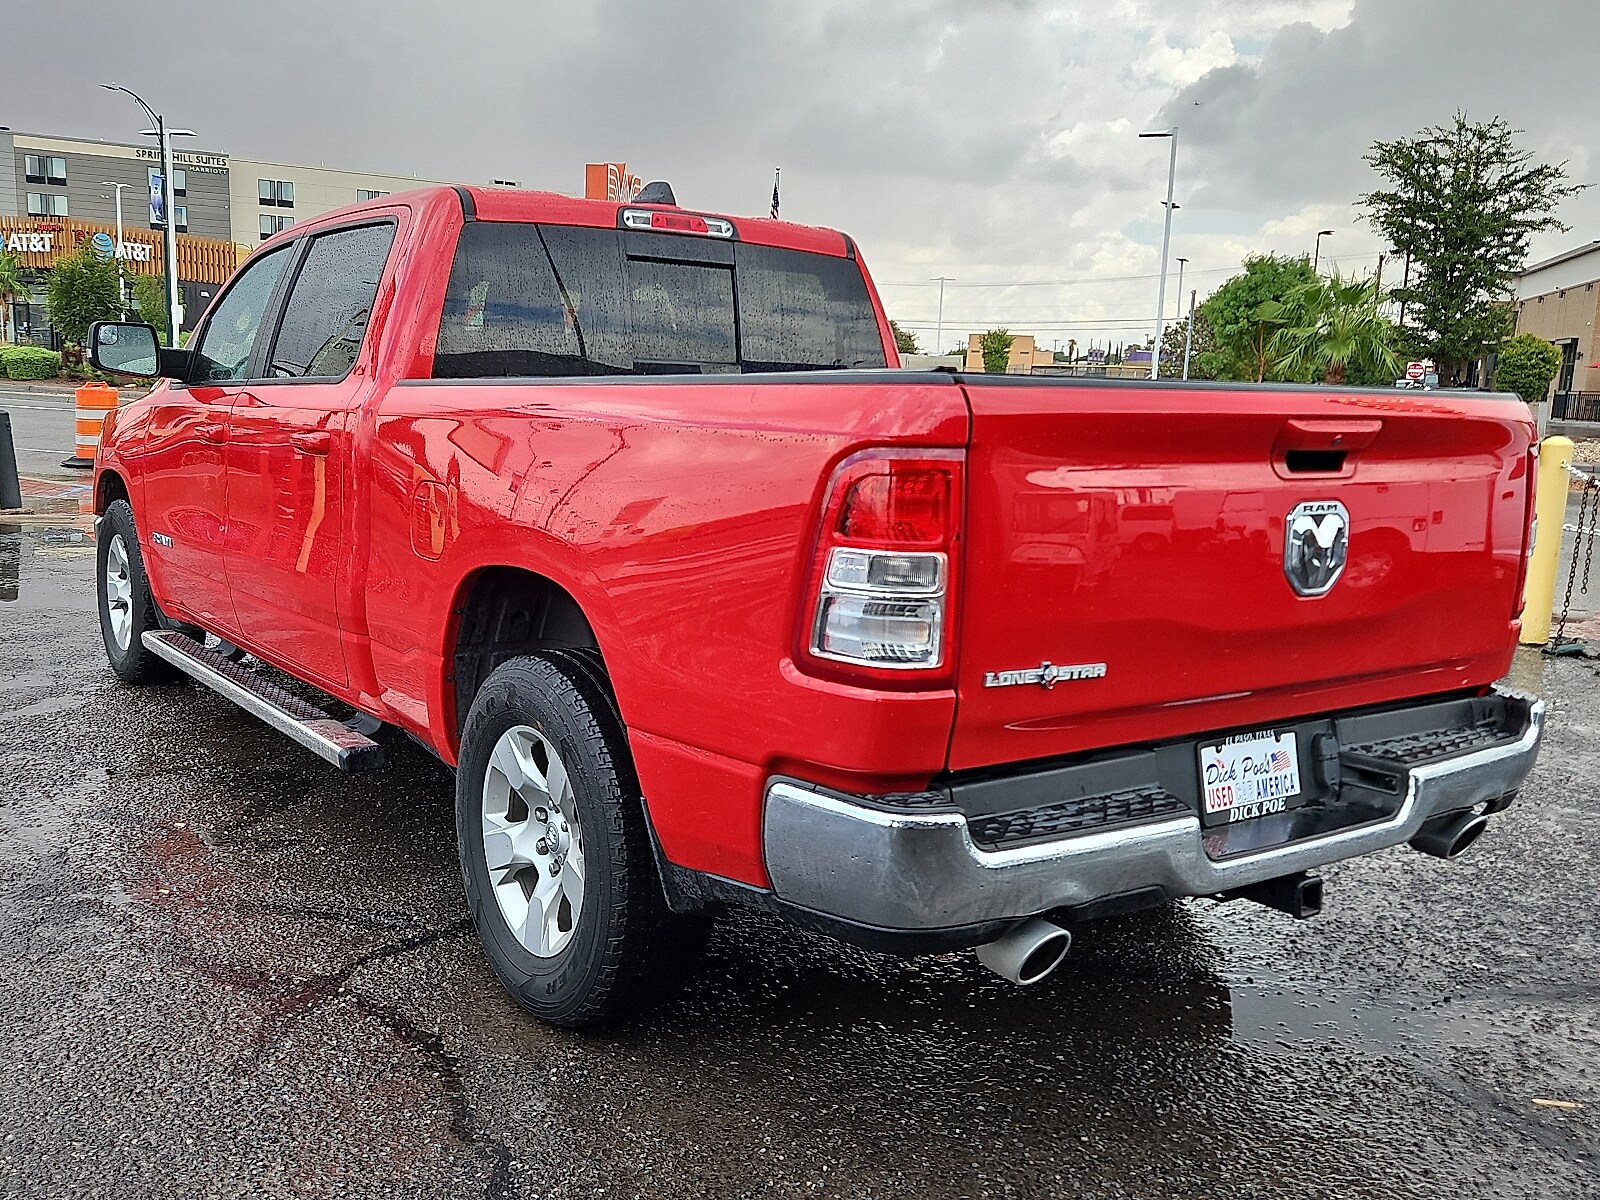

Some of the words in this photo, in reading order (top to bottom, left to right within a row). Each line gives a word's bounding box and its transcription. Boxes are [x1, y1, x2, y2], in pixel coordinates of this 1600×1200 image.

[135, 149, 193, 163] SPRINHILL
[195, 155, 227, 167] SUITES
[189, 165, 228, 175] MARRIOTT
[7, 233, 54, 252] AT&T
[115, 241, 153, 262] AT&T
[1303, 504, 1338, 512] RAM
[984, 668, 1041, 687] LONE
[1056, 662, 1107, 681] STAR
[1206, 759, 1238, 785] Dick
[1208, 785, 1234, 810] USED
[1256, 773, 1296, 801] AMERICA
[1229, 802, 1261, 822] DICK
[1261, 797, 1287, 815] POE
